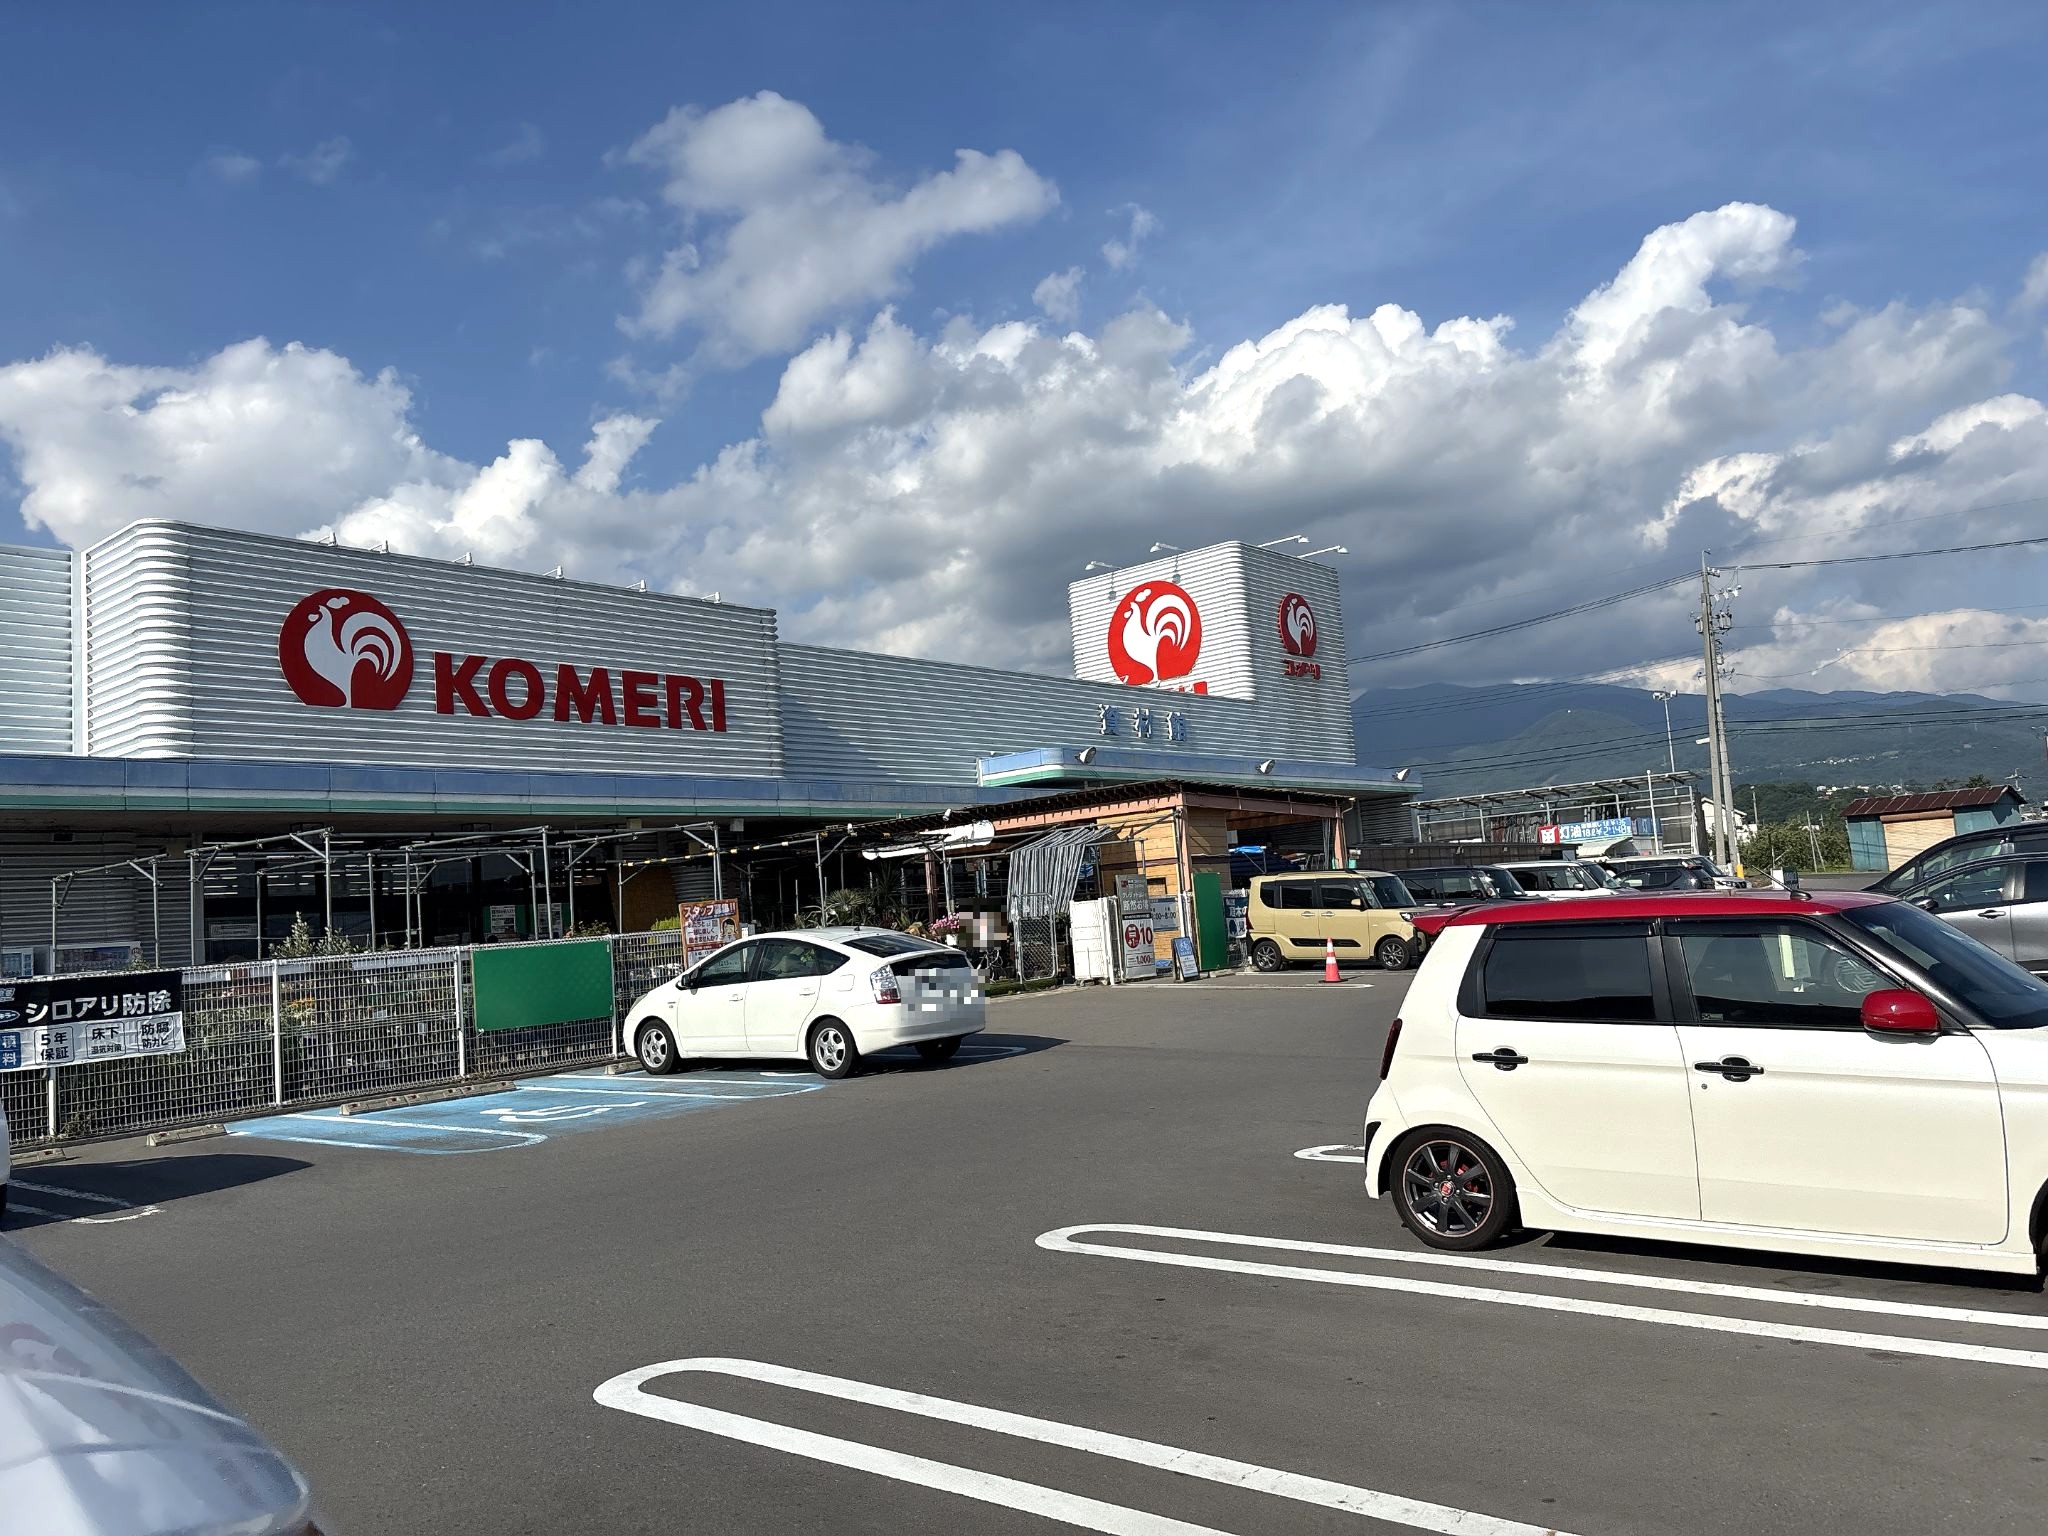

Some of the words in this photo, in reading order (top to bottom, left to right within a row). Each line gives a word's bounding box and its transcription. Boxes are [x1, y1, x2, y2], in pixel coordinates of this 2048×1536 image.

[433, 651, 727, 733] KOMERI
[1560, 824, 1582, 839] 灯油
[25, 989, 172, 1024] シロアリ防除
[92, 1026, 119, 1041] 床下
[141, 1021, 170, 1037] 防腐
[41, 1032, 68, 1046] 5年
[41, 1047, 70, 1062] 保証
